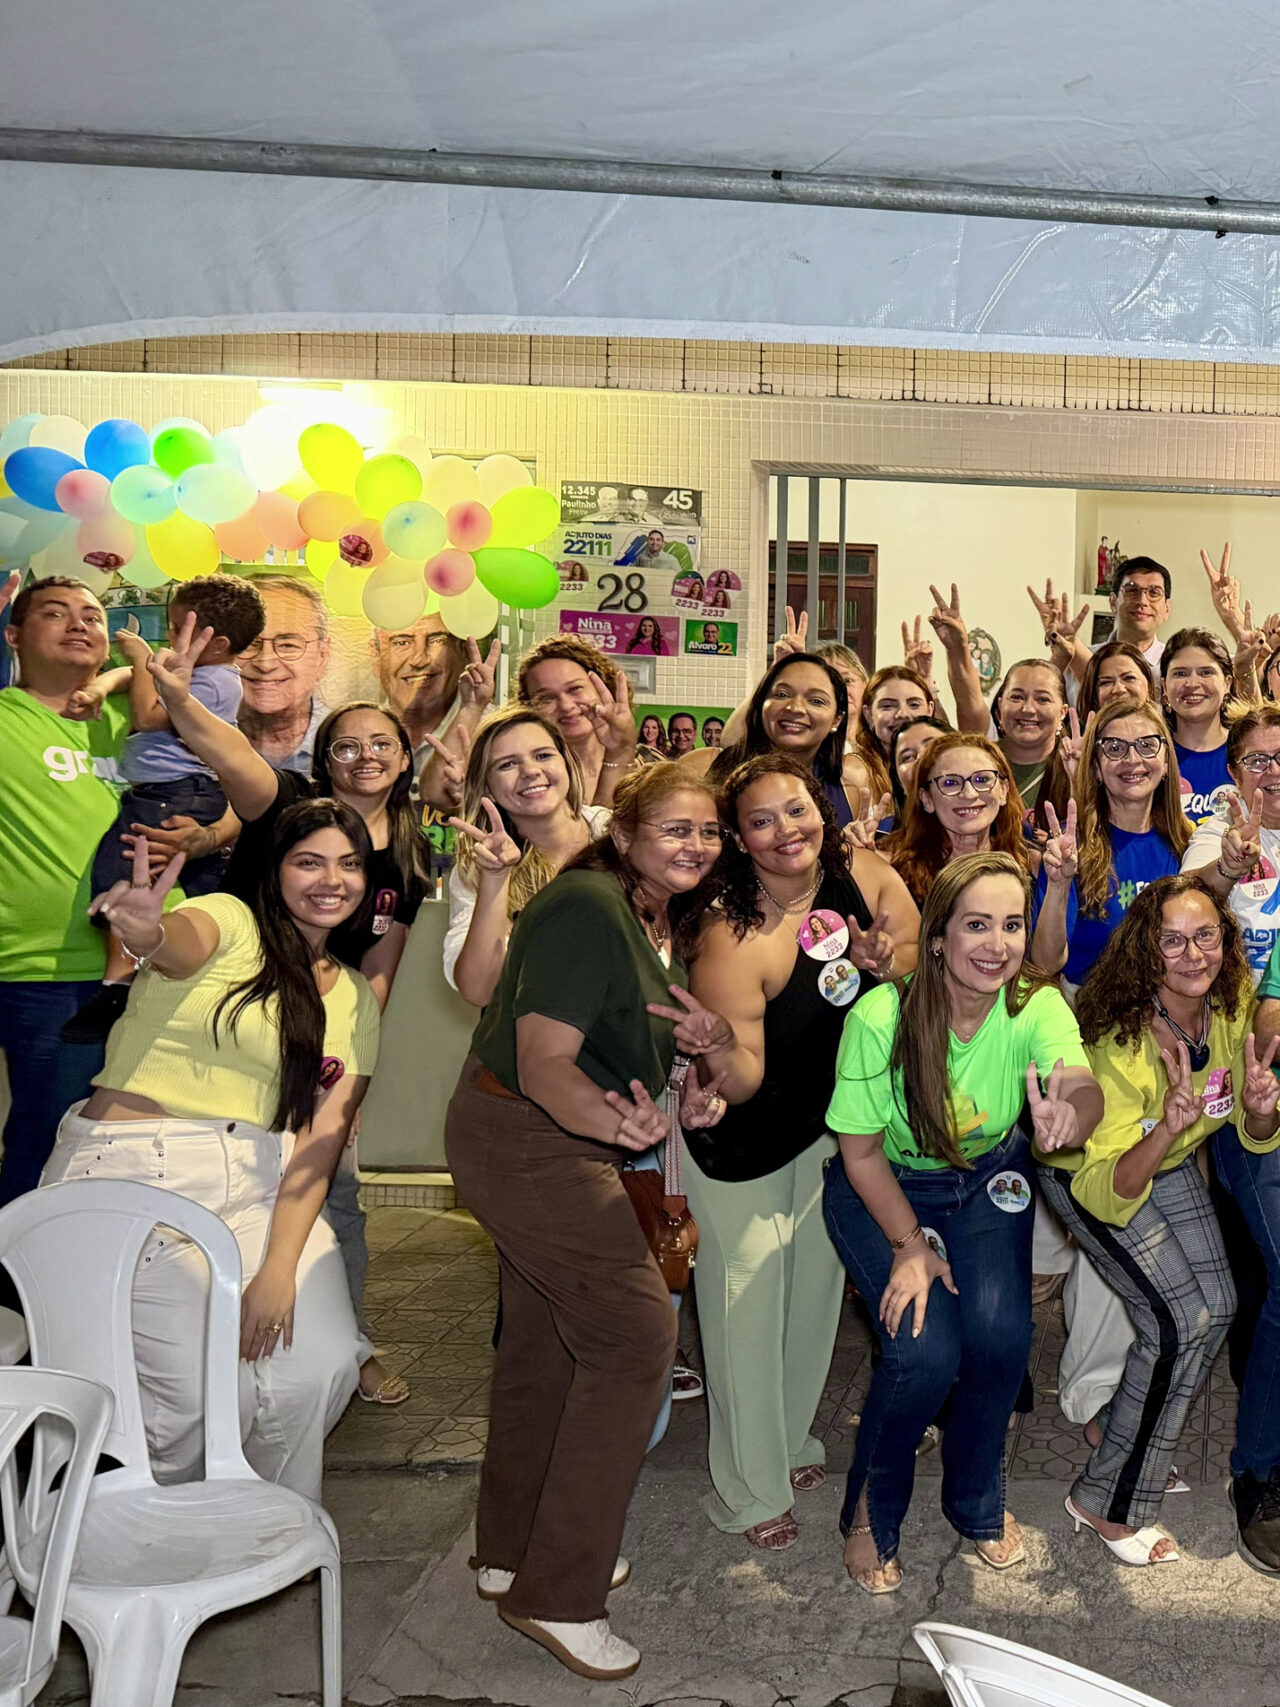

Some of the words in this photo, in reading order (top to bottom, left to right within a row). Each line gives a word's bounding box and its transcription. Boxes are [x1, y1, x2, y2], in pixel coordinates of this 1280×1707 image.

[561, 485, 596, 496] 12.345
[561, 499, 597, 509] Paulinho
[663, 489, 693, 510] 45
[563, 538, 612, 556] 22111
[560, 583, 584, 591] 2233
[597, 573, 649, 613] 28
[675, 598, 699, 610] 2233
[701, 608, 726, 618] 2233
[577, 617, 612, 630] Nina
[688, 640, 717, 650] Alvaro
[718, 642, 733, 654] 22
[1253, 889, 1269, 898] 2233
[826, 942, 844, 958] 2233
